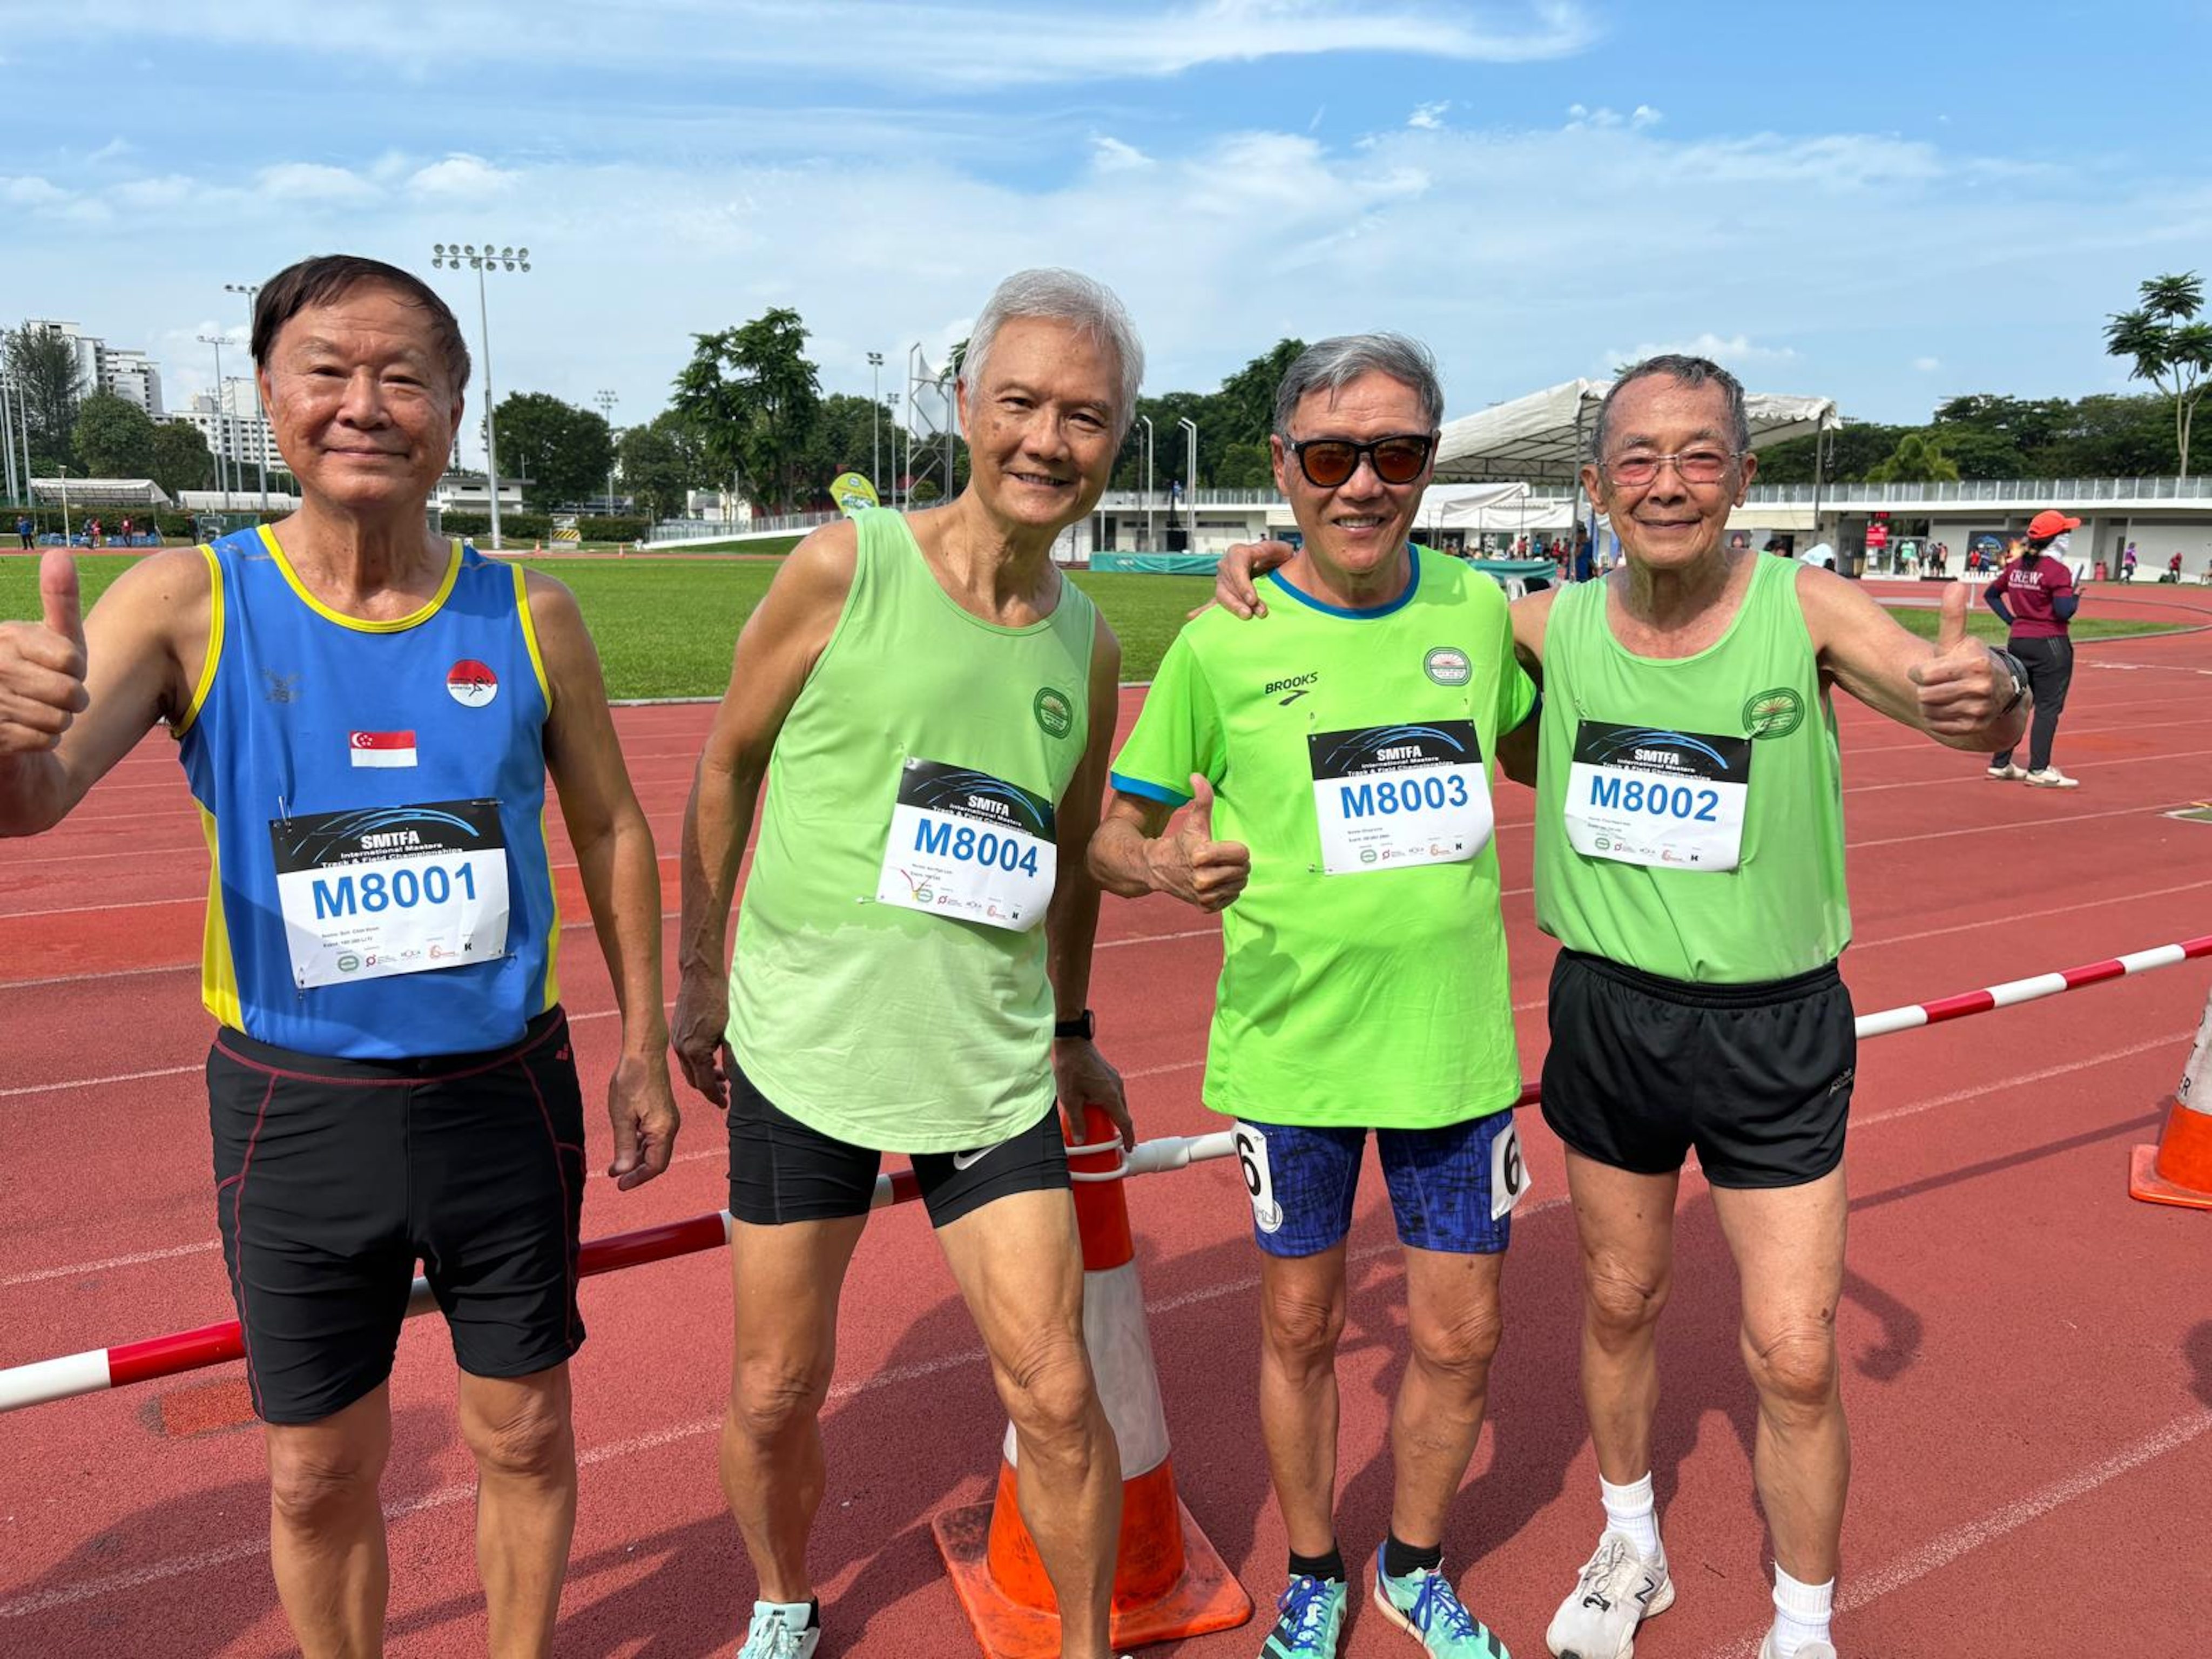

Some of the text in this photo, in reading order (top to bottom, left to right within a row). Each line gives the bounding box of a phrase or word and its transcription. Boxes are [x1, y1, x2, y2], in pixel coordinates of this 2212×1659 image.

[1264, 671, 1318, 694] BROOKS
[1361, 759, 1408, 769] International
[1377, 745, 1422, 761] SMTFA
[1635, 748, 1680, 765] SMTFA
[1617, 758, 1696, 773] International Masters
[968, 795, 1009, 817] SMTFA
[1340, 775, 1468, 819] M8003
[1590, 775, 1719, 822] M8002
[949, 803, 1022, 827] International Masters
[341, 842, 442, 859] International Masters
[361, 830, 420, 850] SMTFA
[915, 818, 1037, 877] M8004
[313, 862, 476, 919] M8001
[1236, 1132, 1260, 1196] 6
[1504, 1130, 1520, 1196] 6
